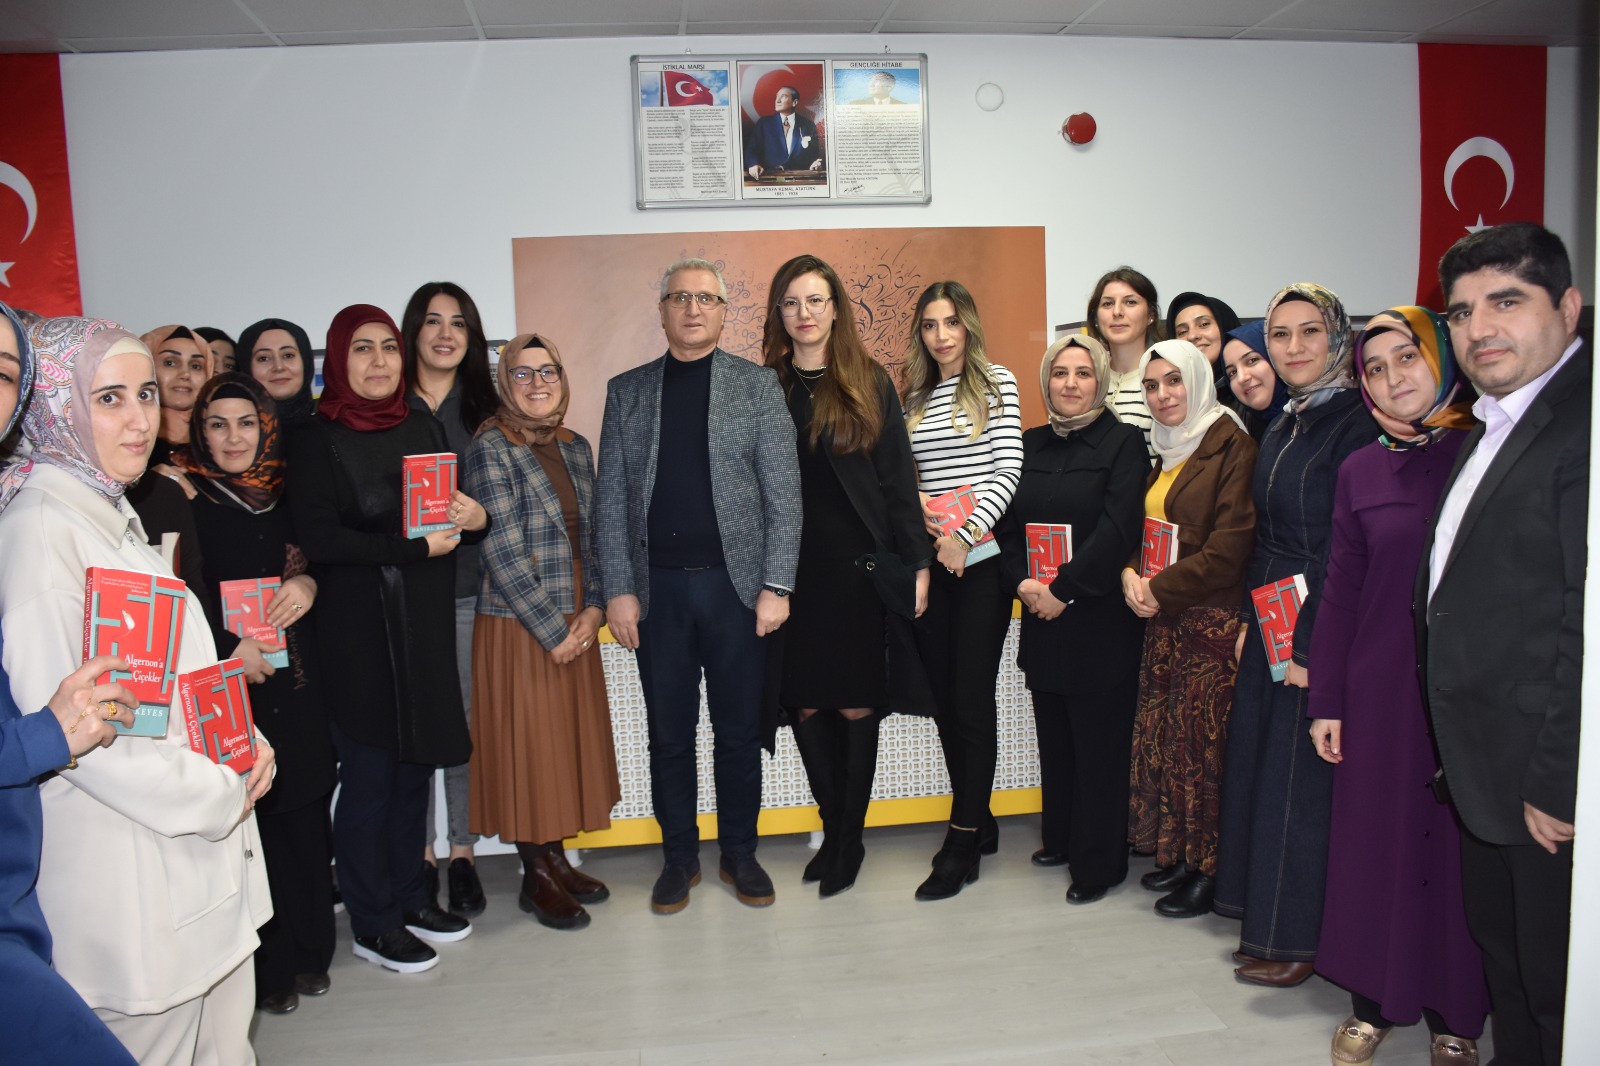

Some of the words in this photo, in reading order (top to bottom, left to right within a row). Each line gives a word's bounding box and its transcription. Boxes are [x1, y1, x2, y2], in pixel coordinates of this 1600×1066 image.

[125, 653, 164, 669] Algernon'a
[132, 670, 162, 684] Çiçekler
[134, 707, 164, 717] KEYES
[181, 682, 194, 719] Algernon'a
[189, 720, 201, 749] Çiçekler
[231, 744, 251, 759] Çiçekler
